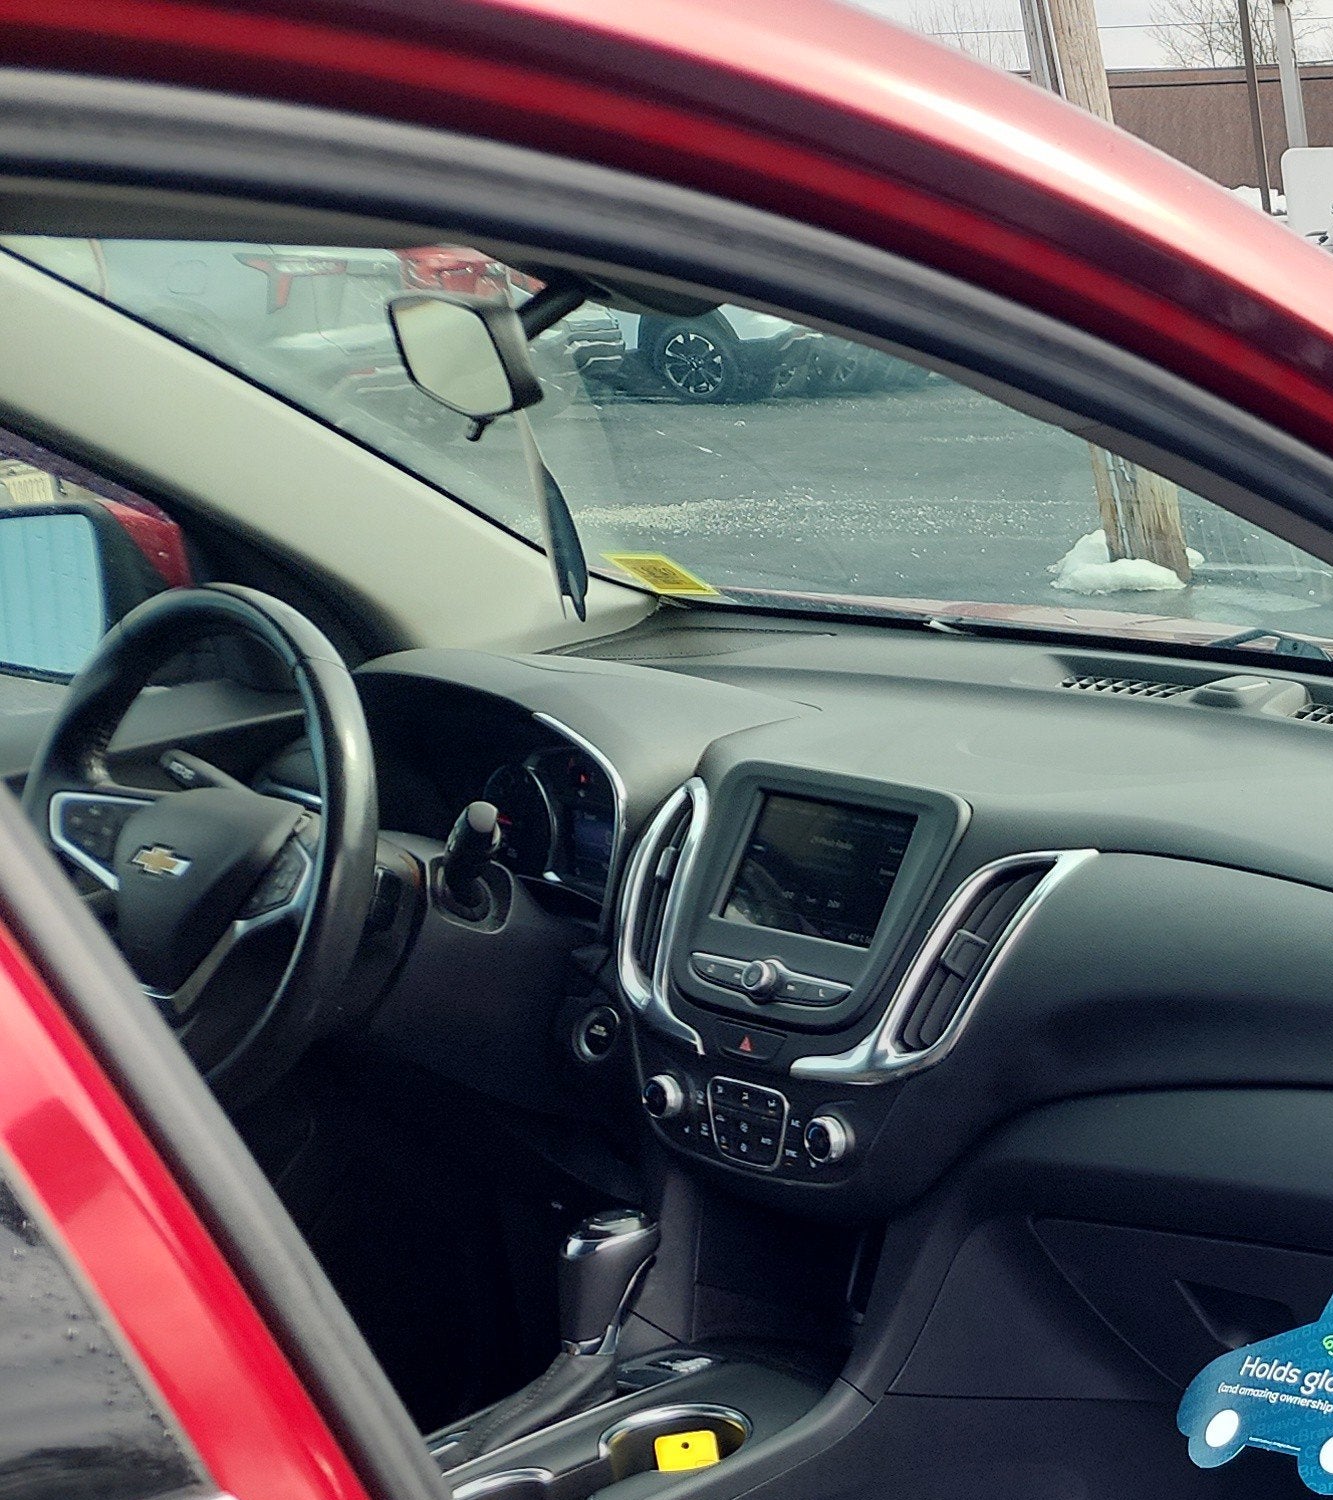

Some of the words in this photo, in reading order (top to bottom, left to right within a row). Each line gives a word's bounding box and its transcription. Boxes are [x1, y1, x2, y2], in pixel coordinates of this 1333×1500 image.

[1239, 1355, 1302, 1384] Holds
[1218, 1381, 1240, 1394] (and
[1239, 1387, 1280, 1404] amazing
